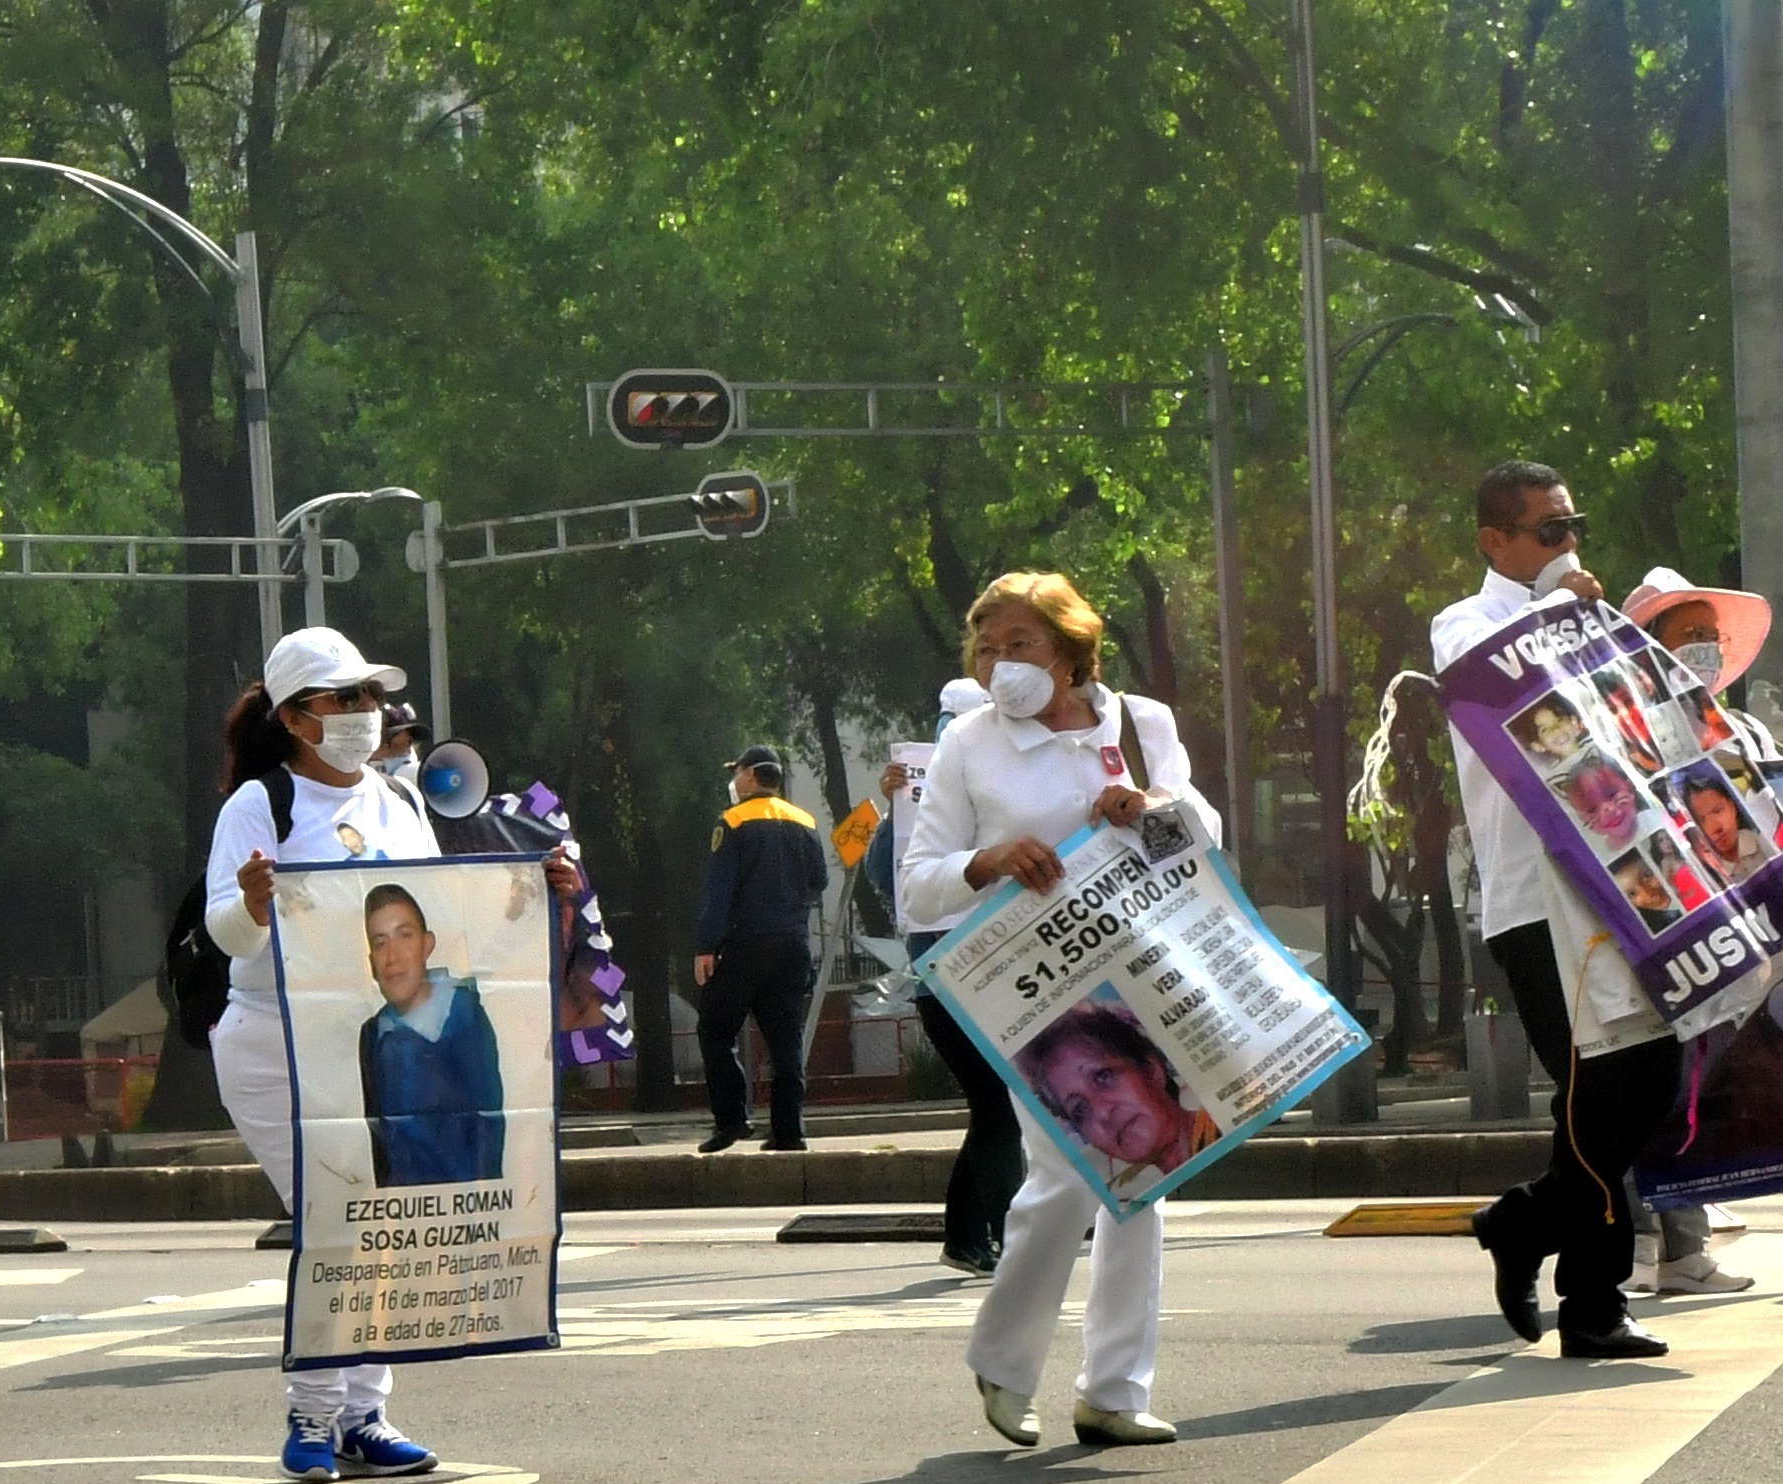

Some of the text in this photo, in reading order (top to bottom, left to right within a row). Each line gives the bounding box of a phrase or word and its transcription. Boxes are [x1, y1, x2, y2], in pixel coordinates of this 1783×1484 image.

[1034, 852, 1151, 946] RECOMPEN
[345, 1189, 513, 1223] EZEQUIEL ROMAN
[360, 1229, 418, 1252] SOSA
[312, 1257, 411, 1286] Desapareció
[414, 1260, 432, 1278] en
[507, 1245, 542, 1268] Mich.
[329, 1293, 344, 1313] el
[378, 1289, 398, 1311] 16
[401, 1285, 419, 1306] de
[423, 1287, 467, 1308] marzo
[469, 1279, 490, 1302] del
[493, 1276, 524, 1301] 2017
[384, 1319, 421, 1342] edad
[425, 1316, 445, 1338] de
[448, 1314, 467, 1336] 27
